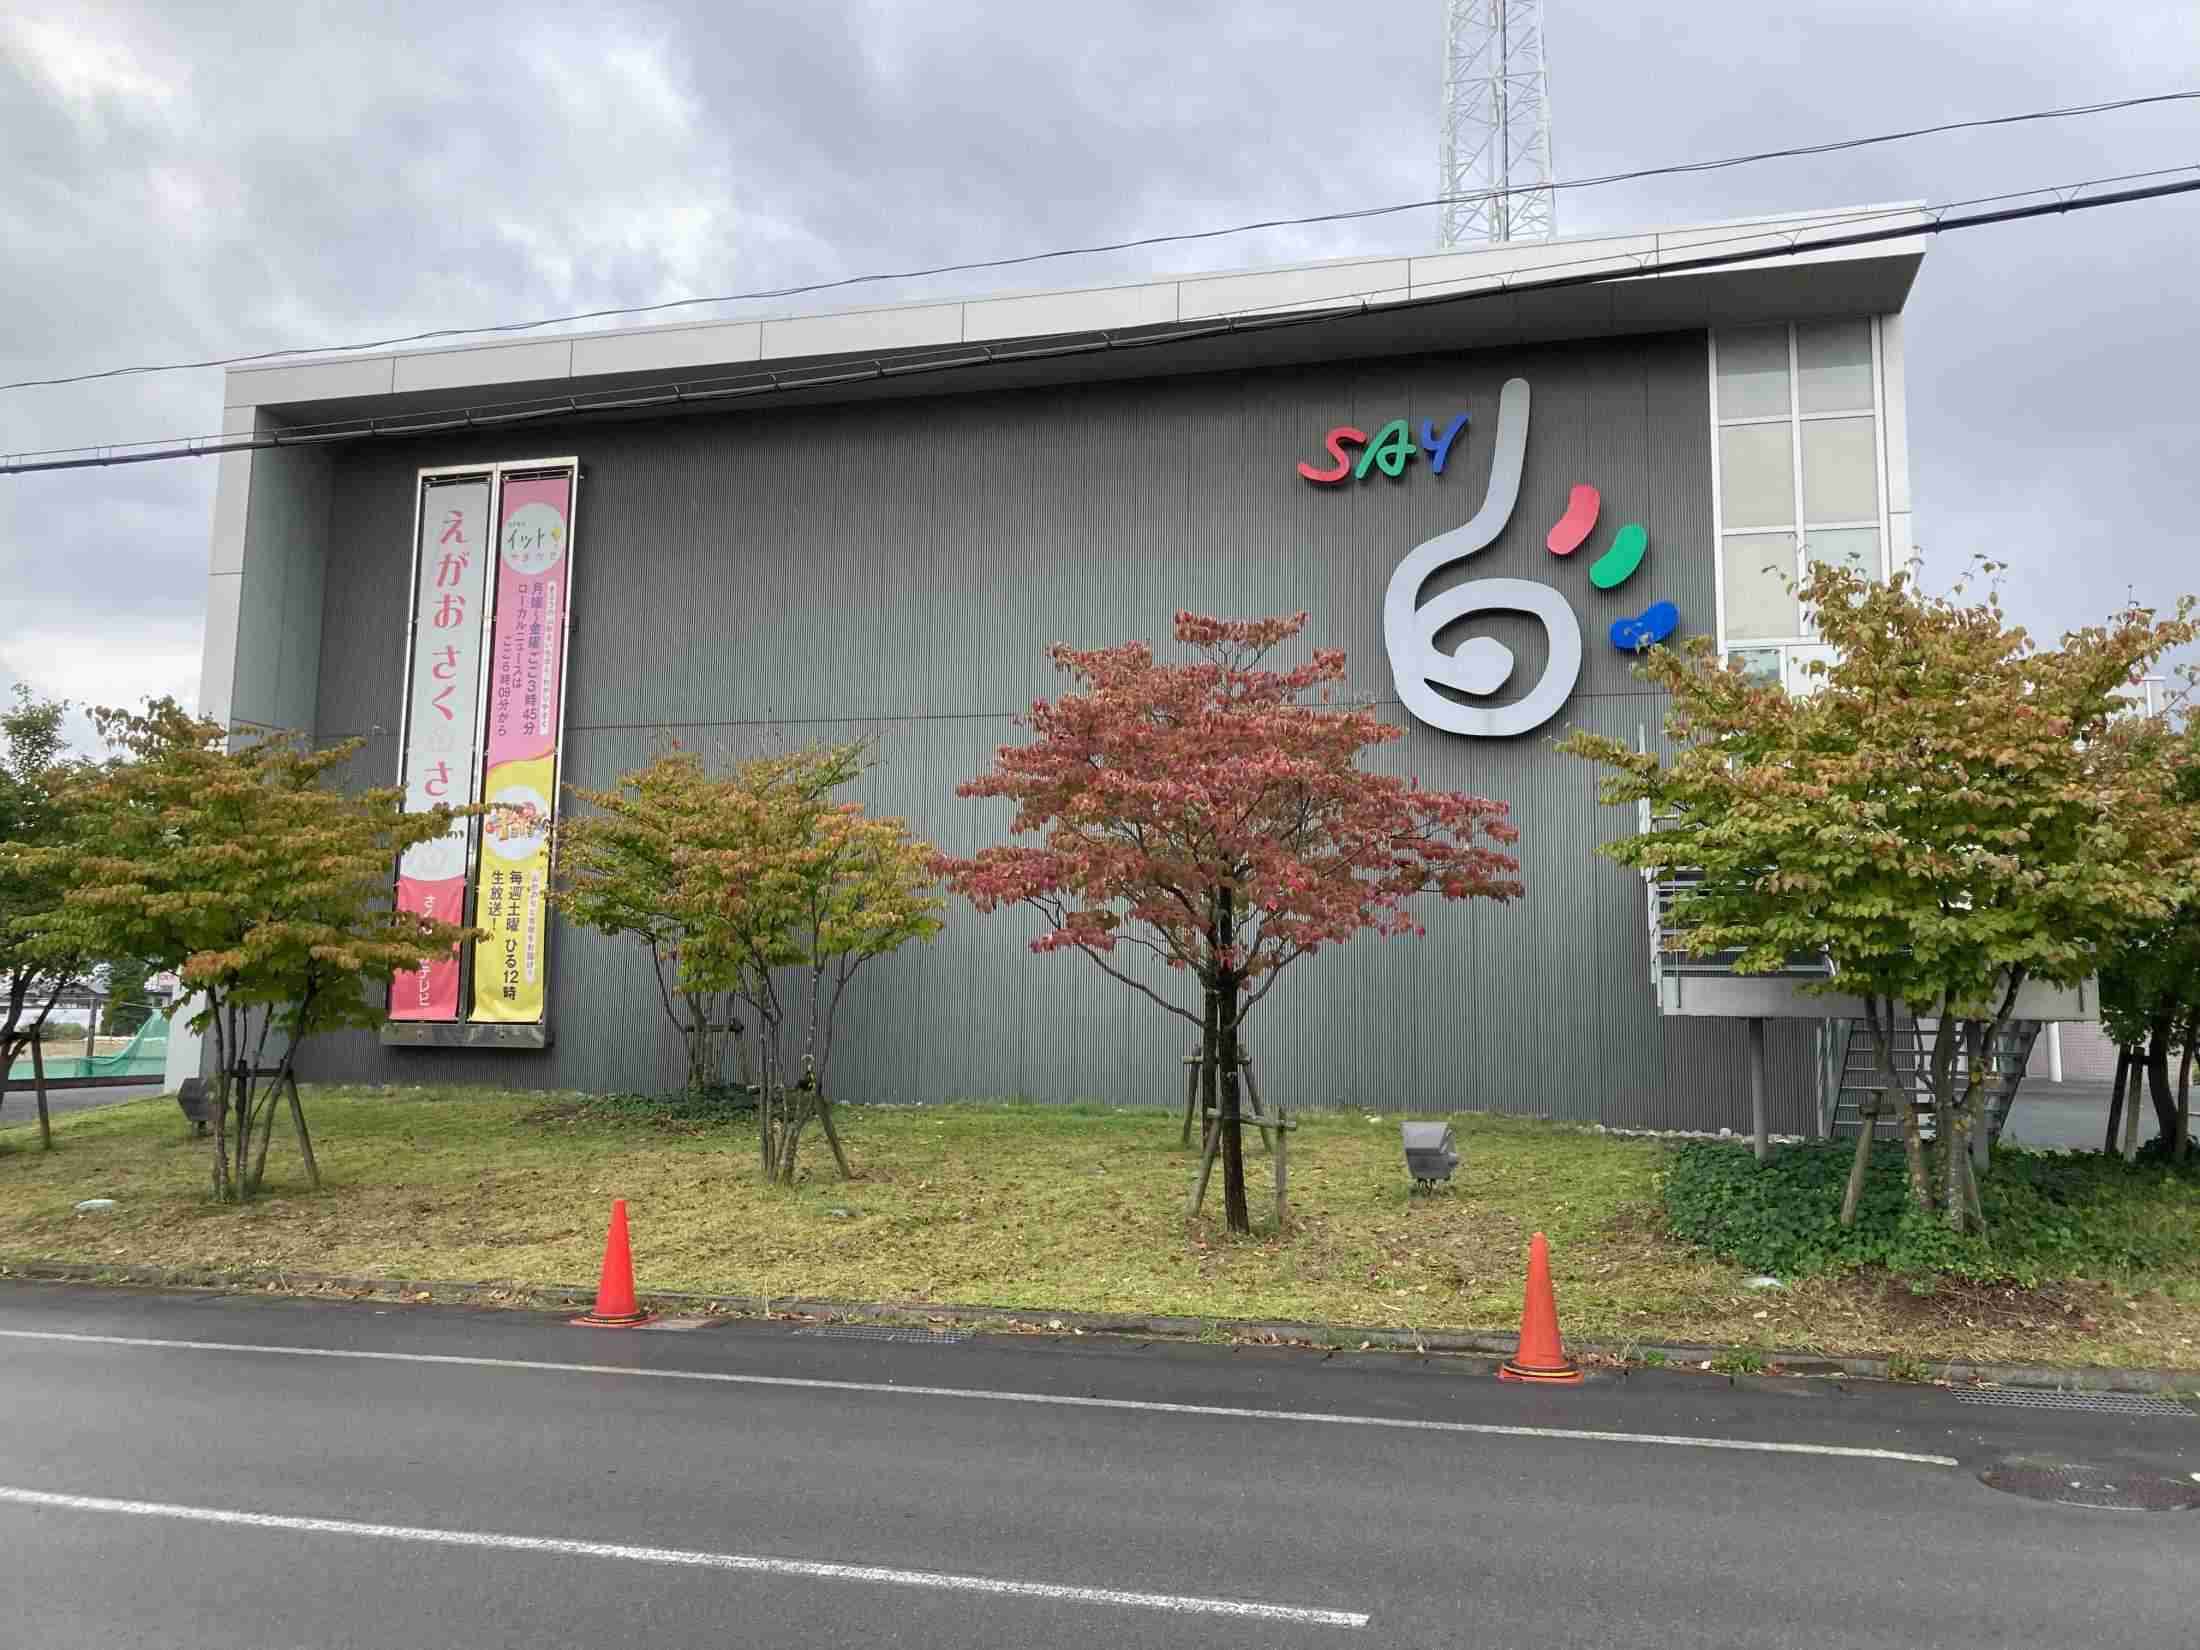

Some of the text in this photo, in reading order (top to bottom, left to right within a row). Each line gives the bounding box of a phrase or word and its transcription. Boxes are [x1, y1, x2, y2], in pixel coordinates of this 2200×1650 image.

[1297, 413, 1471, 483] SAY
[431, 510, 470, 721] えがおさく
